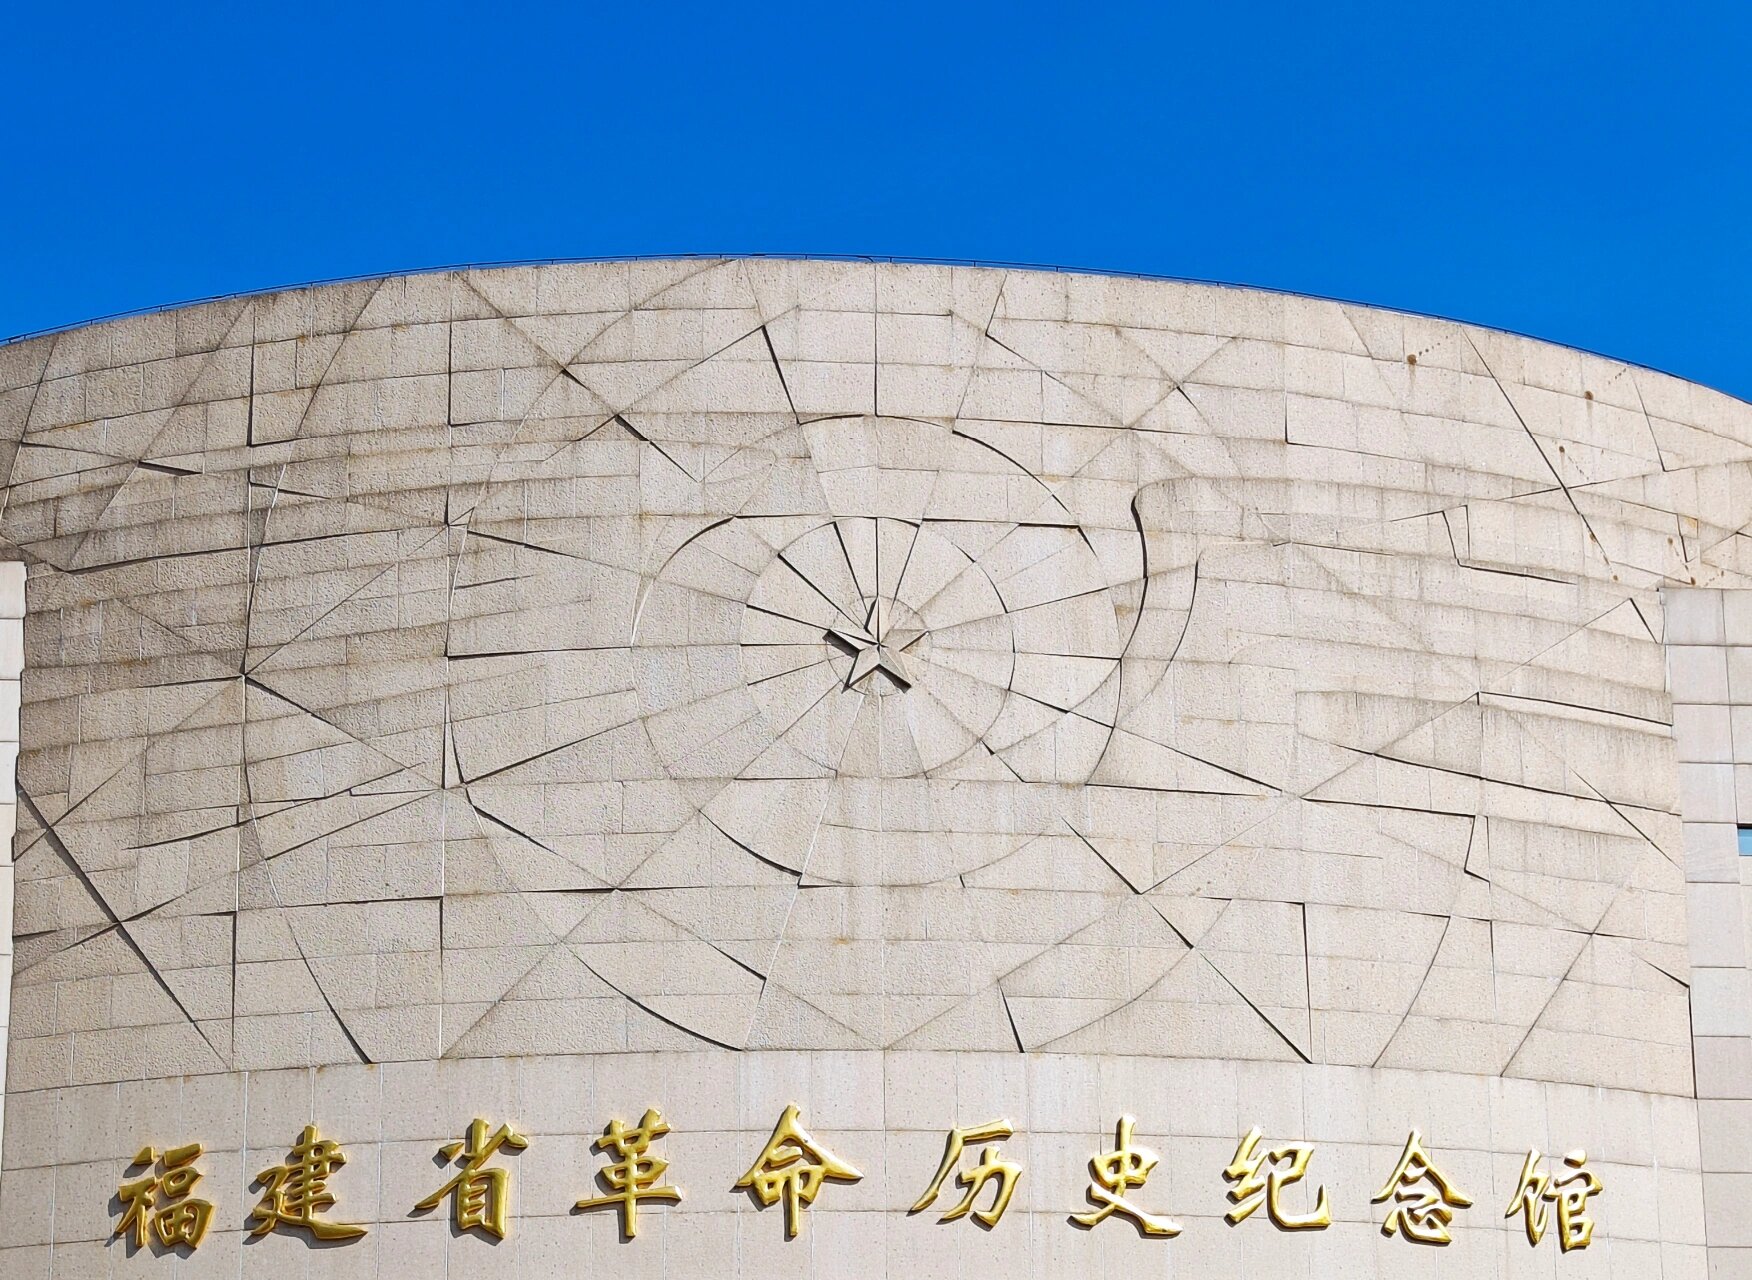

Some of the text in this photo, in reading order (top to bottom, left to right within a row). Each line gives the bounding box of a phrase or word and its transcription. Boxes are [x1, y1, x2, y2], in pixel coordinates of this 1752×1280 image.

[113, 1105, 1604, 1251] 福建省革命历史纪念馆
